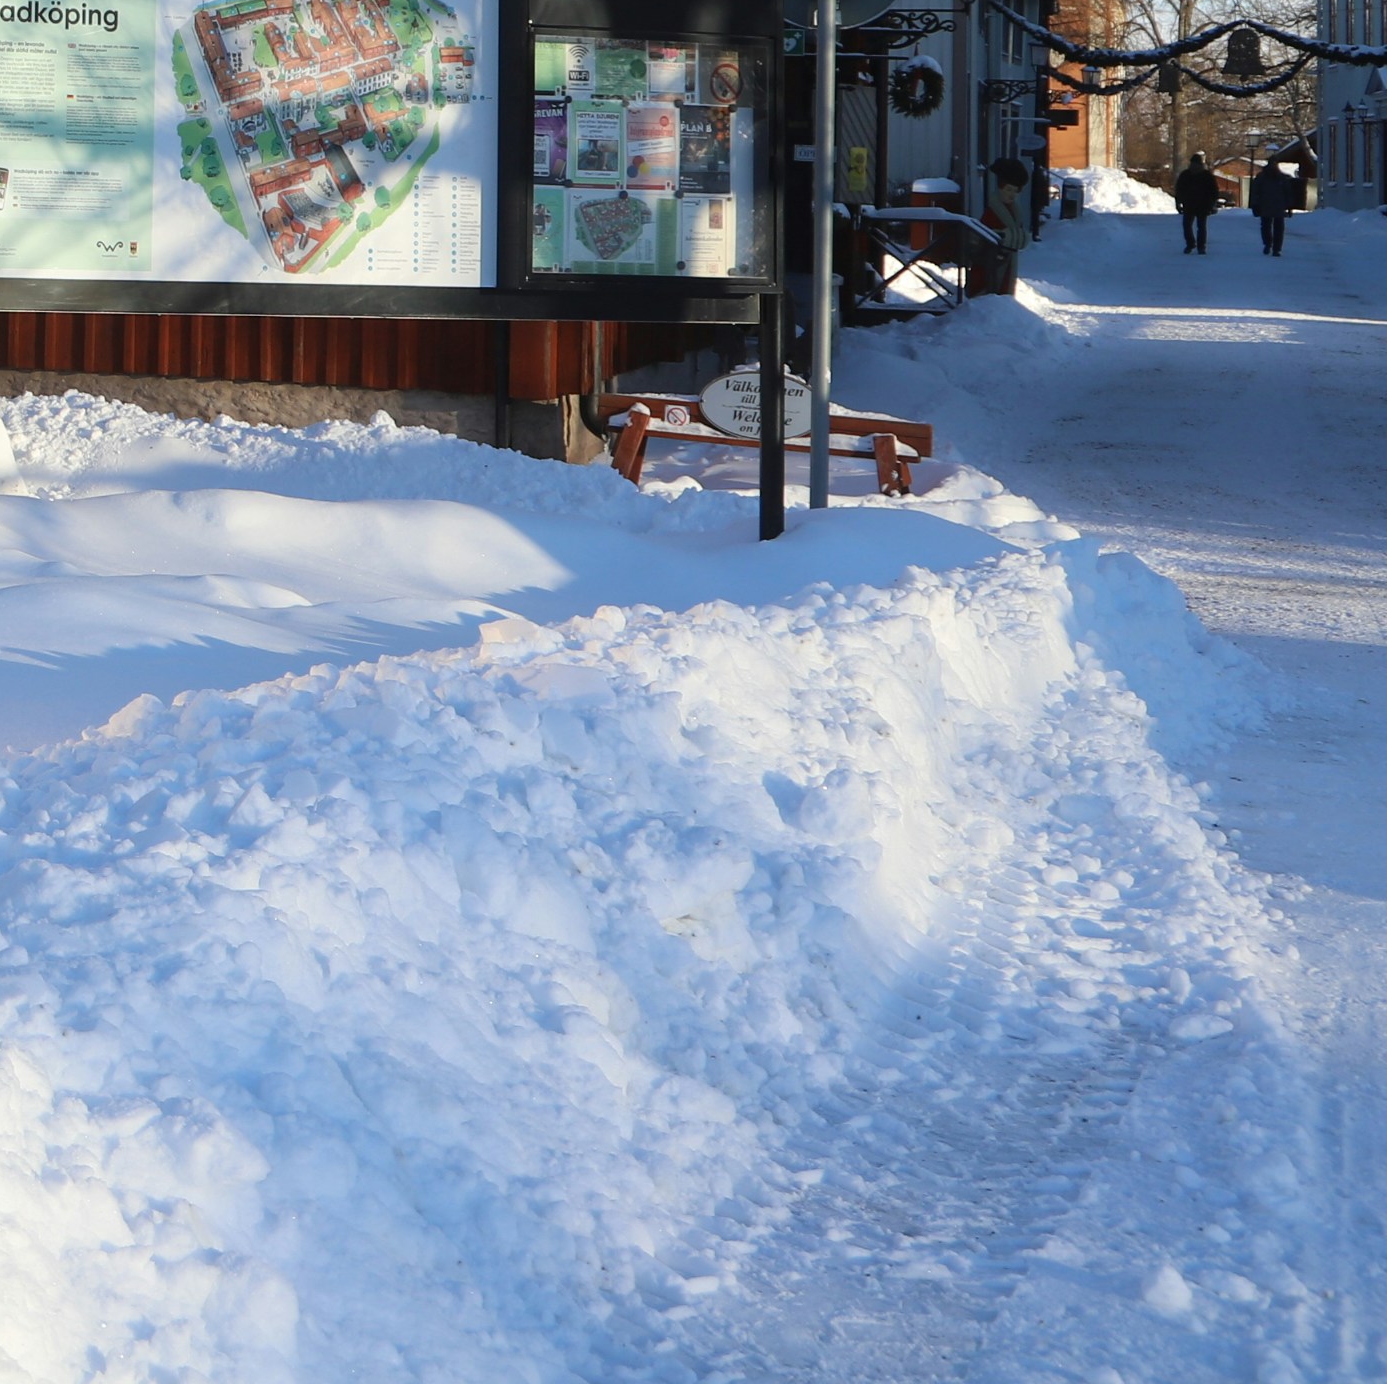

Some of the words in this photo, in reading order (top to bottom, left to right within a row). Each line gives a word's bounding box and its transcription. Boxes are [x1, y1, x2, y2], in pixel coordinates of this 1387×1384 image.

[570, 71, 589, 81] Wi-Fi
[725, 379, 804, 397] Välkoen
[741, 394, 756, 404] till
[732, 409, 793, 426] Welce
[739, 425, 753, 433] on
